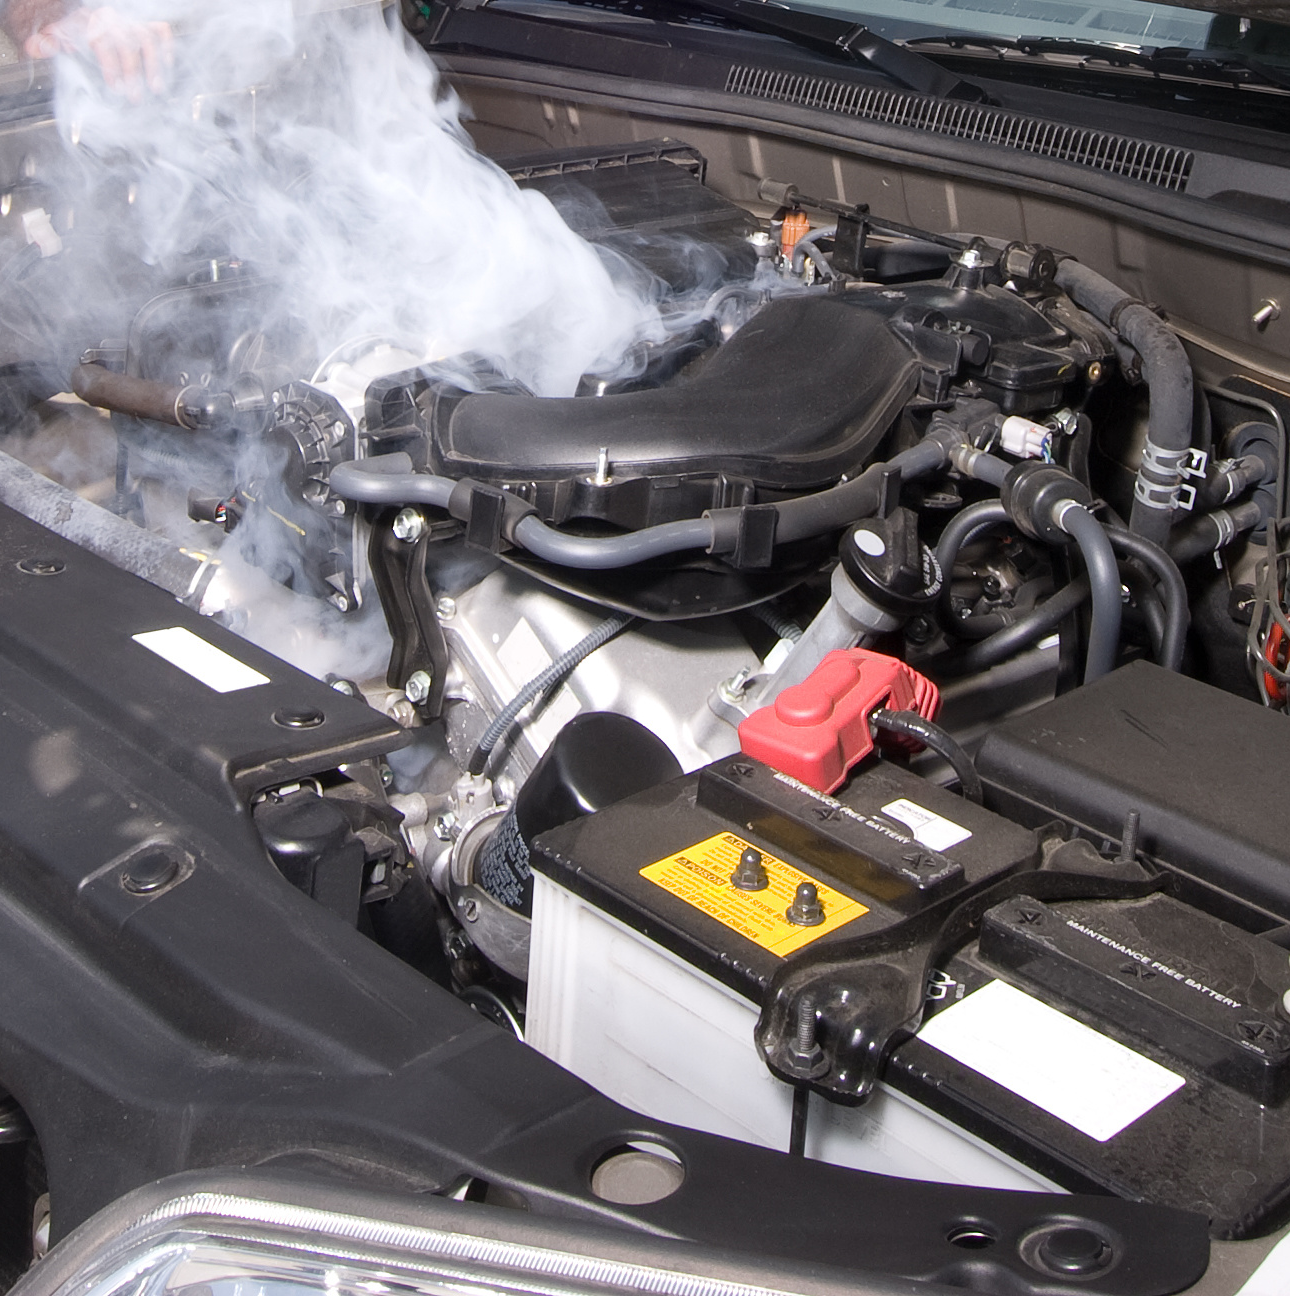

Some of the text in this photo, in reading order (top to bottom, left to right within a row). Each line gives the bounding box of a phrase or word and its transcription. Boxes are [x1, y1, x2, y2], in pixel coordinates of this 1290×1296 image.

[772, 772, 841, 810] MAINTENANCE
[839, 806, 867, 822] FREE
[865, 820, 911, 844] BATTERY
[685, 860, 726, 886] POISON
[1065, 919, 1242, 1009] MAINTENANCE FREE BATTERY
